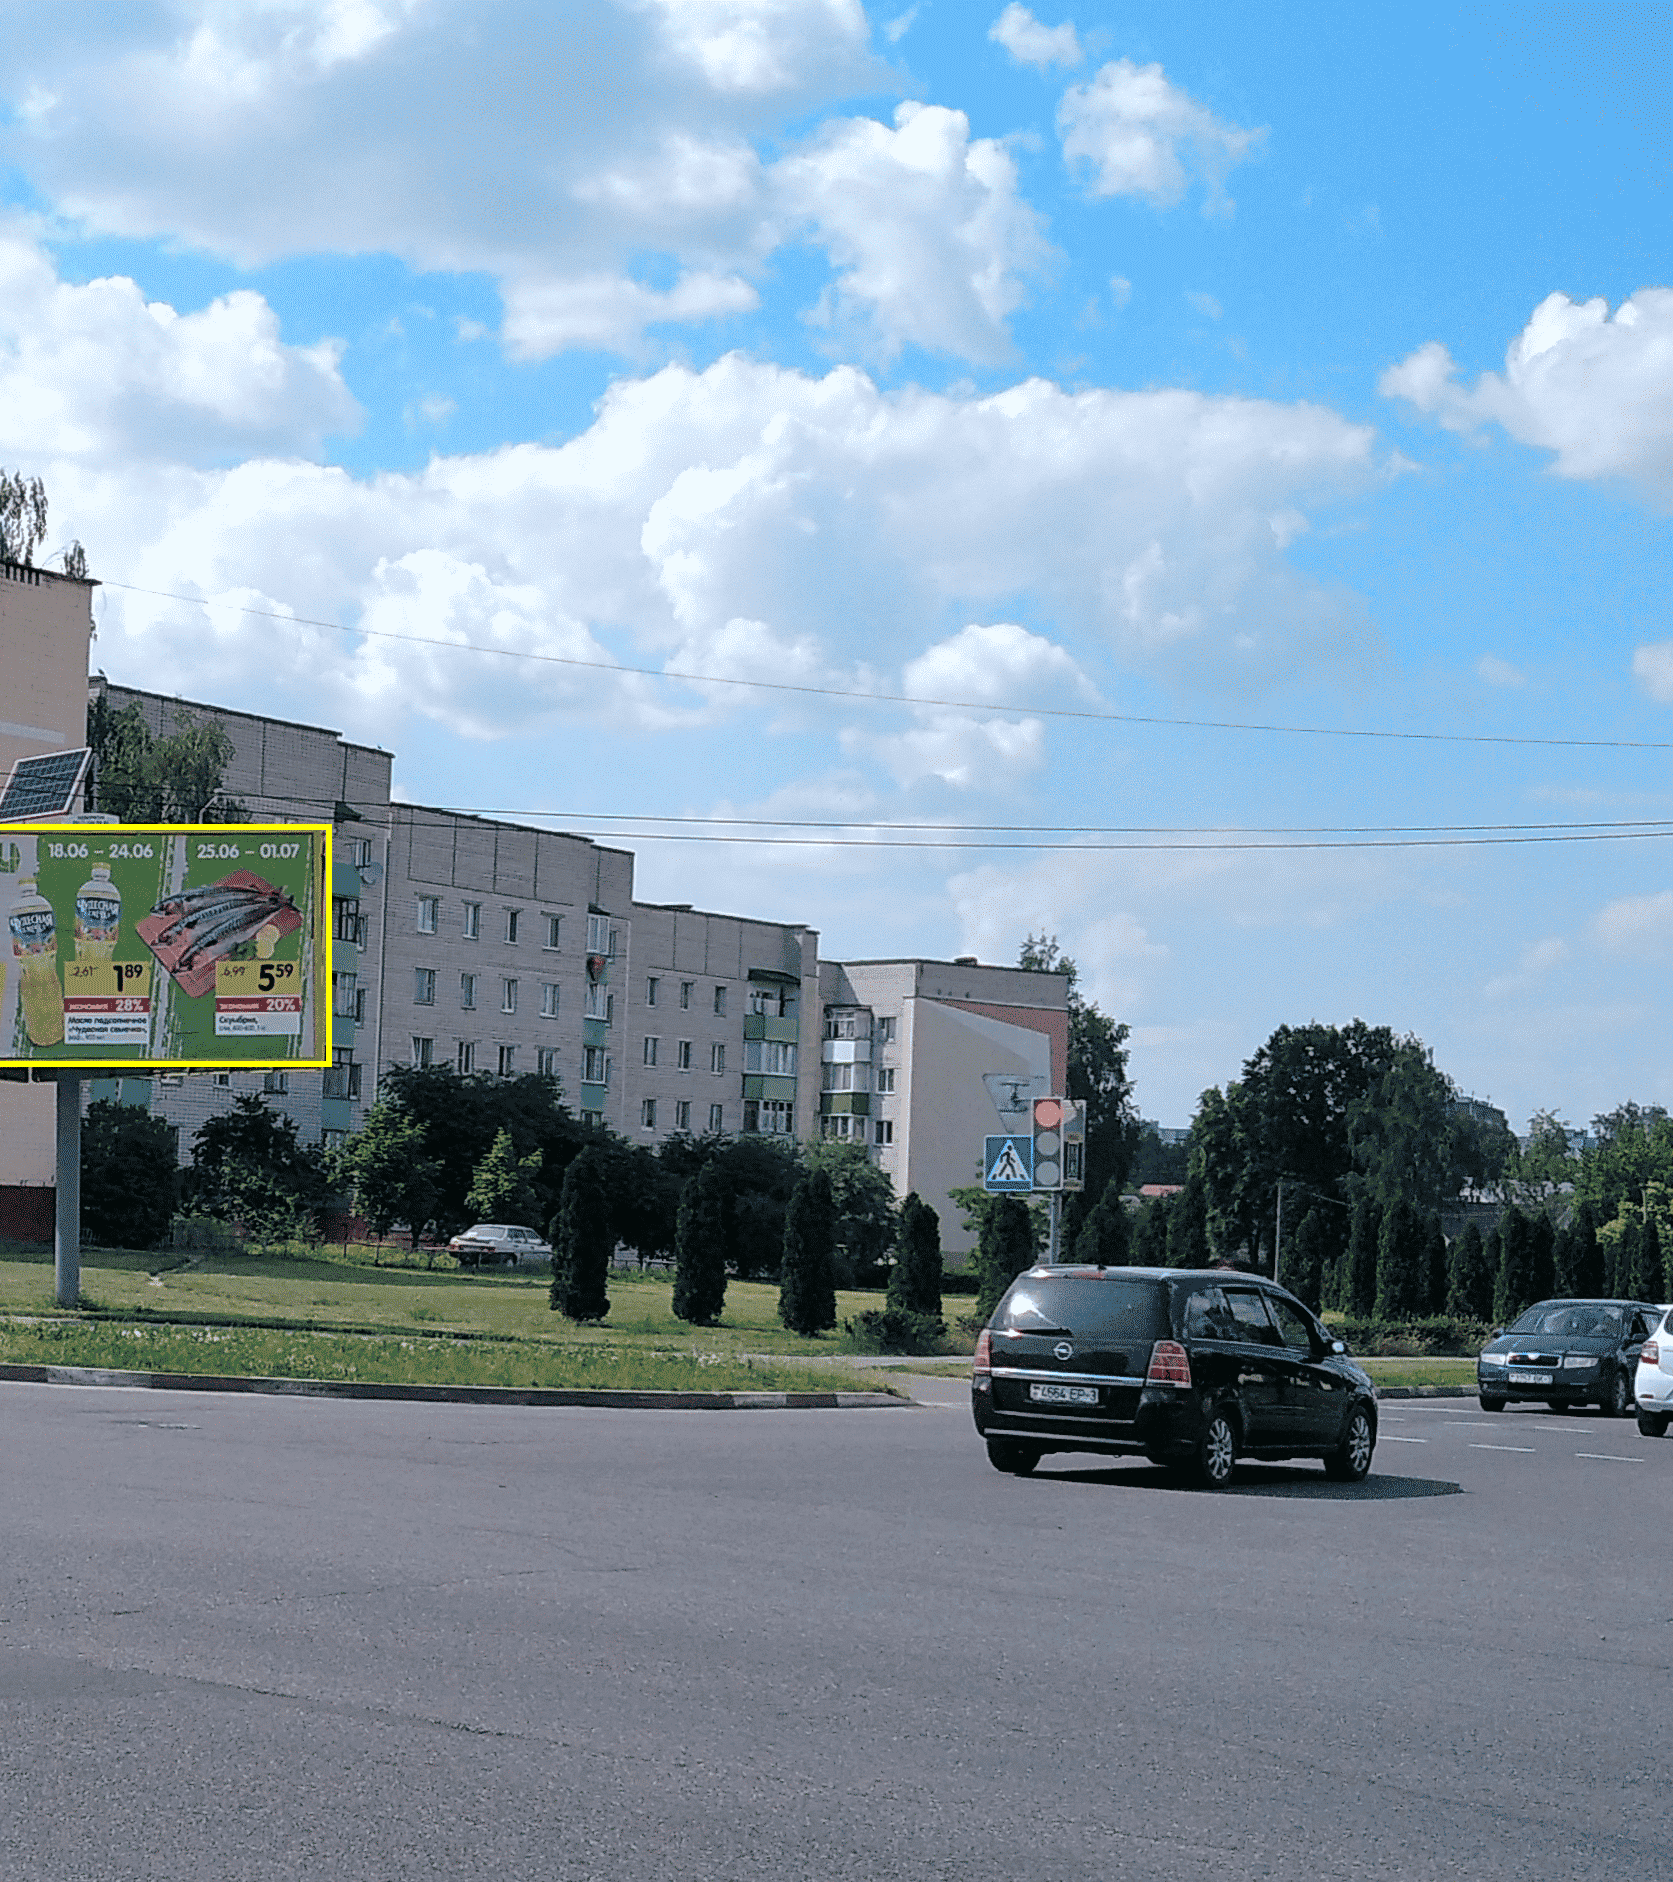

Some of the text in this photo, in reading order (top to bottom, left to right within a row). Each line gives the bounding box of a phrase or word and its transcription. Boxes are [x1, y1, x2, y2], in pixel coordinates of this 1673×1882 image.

[48, 843, 89, 858] 18.06
[109, 843, 153, 858] 24.06
[197, 843, 239, 859] 25.06
[259, 843, 300, 859] 01.07
[115, 998, 144, 1011] 28%
[266, 998, 296, 1011] 20%
